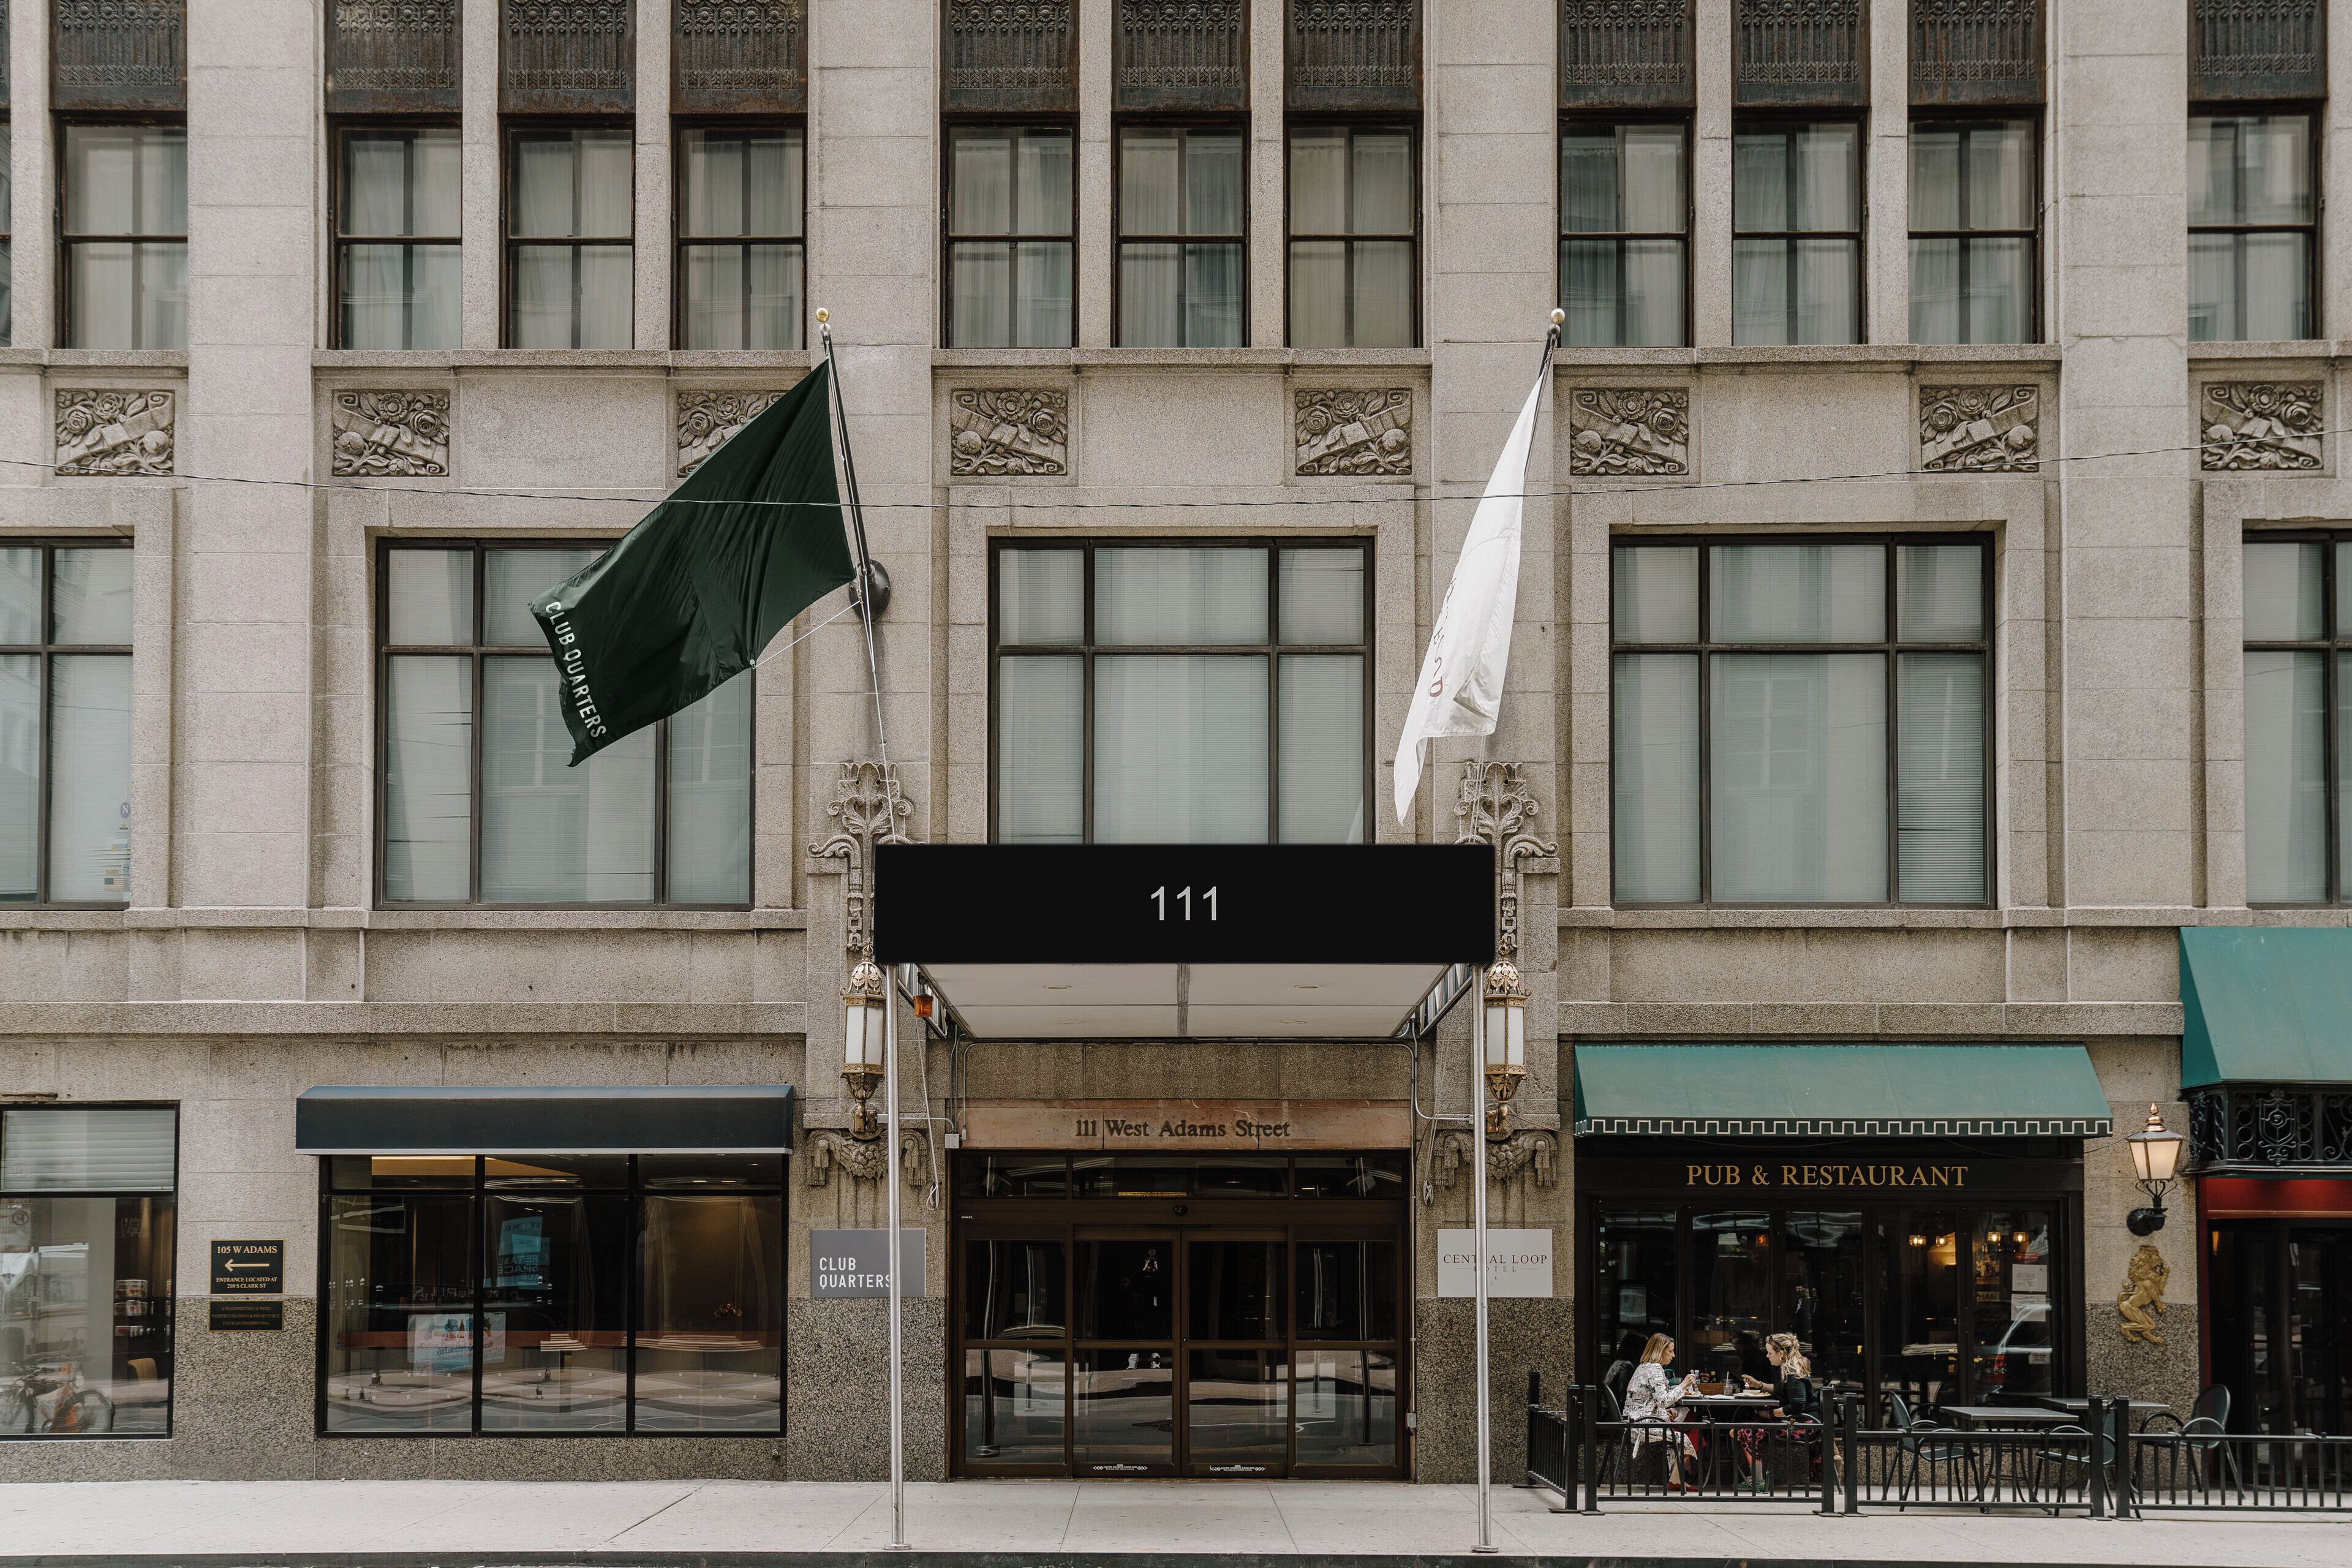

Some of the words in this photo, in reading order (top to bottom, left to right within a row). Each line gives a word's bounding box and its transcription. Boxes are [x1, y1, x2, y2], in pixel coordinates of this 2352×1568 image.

[546, 601, 575, 646] CLUB
[563, 649, 606, 737] QUARTERS
[1151, 886, 1216, 921] 111
[1104, 1120, 1149, 1136] West
[1158, 1120, 1226, 1137] Adams
[1235, 1120, 1290, 1137] Street
[1686, 1165, 1741, 1185] PUB
[1751, 1165, 1770, 1185] &
[1781, 1166, 1969, 1186] RESTAURANT
[820, 1257, 856, 1271] CLUB
[1443, 1254, 1507, 1264] CENTAL
[1512, 1254, 1547, 1264] LOOP
